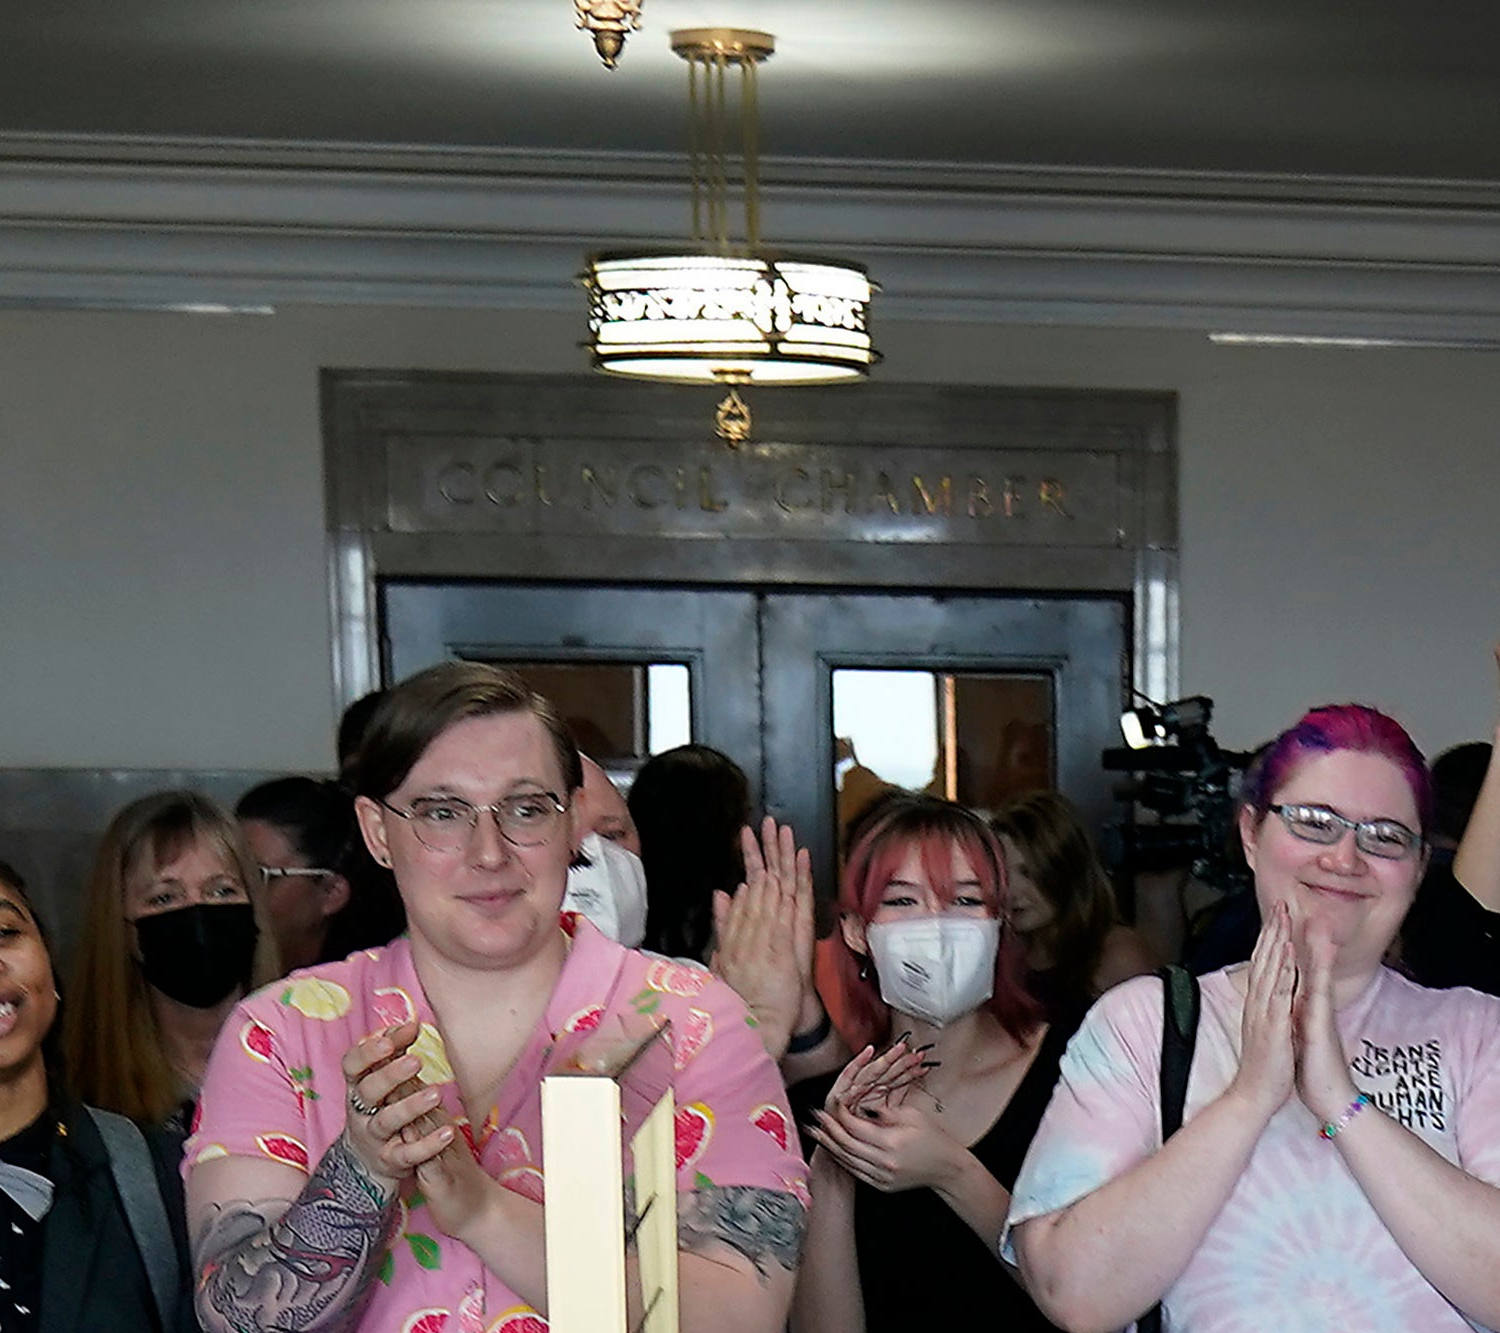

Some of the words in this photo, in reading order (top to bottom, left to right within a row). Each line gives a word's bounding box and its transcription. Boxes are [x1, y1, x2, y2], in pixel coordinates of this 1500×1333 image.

[437, 461, 729, 513] COUNCIL
[773, 467, 1076, 520] CHAMBER
[1398, 1108, 1445, 1131] HTS
